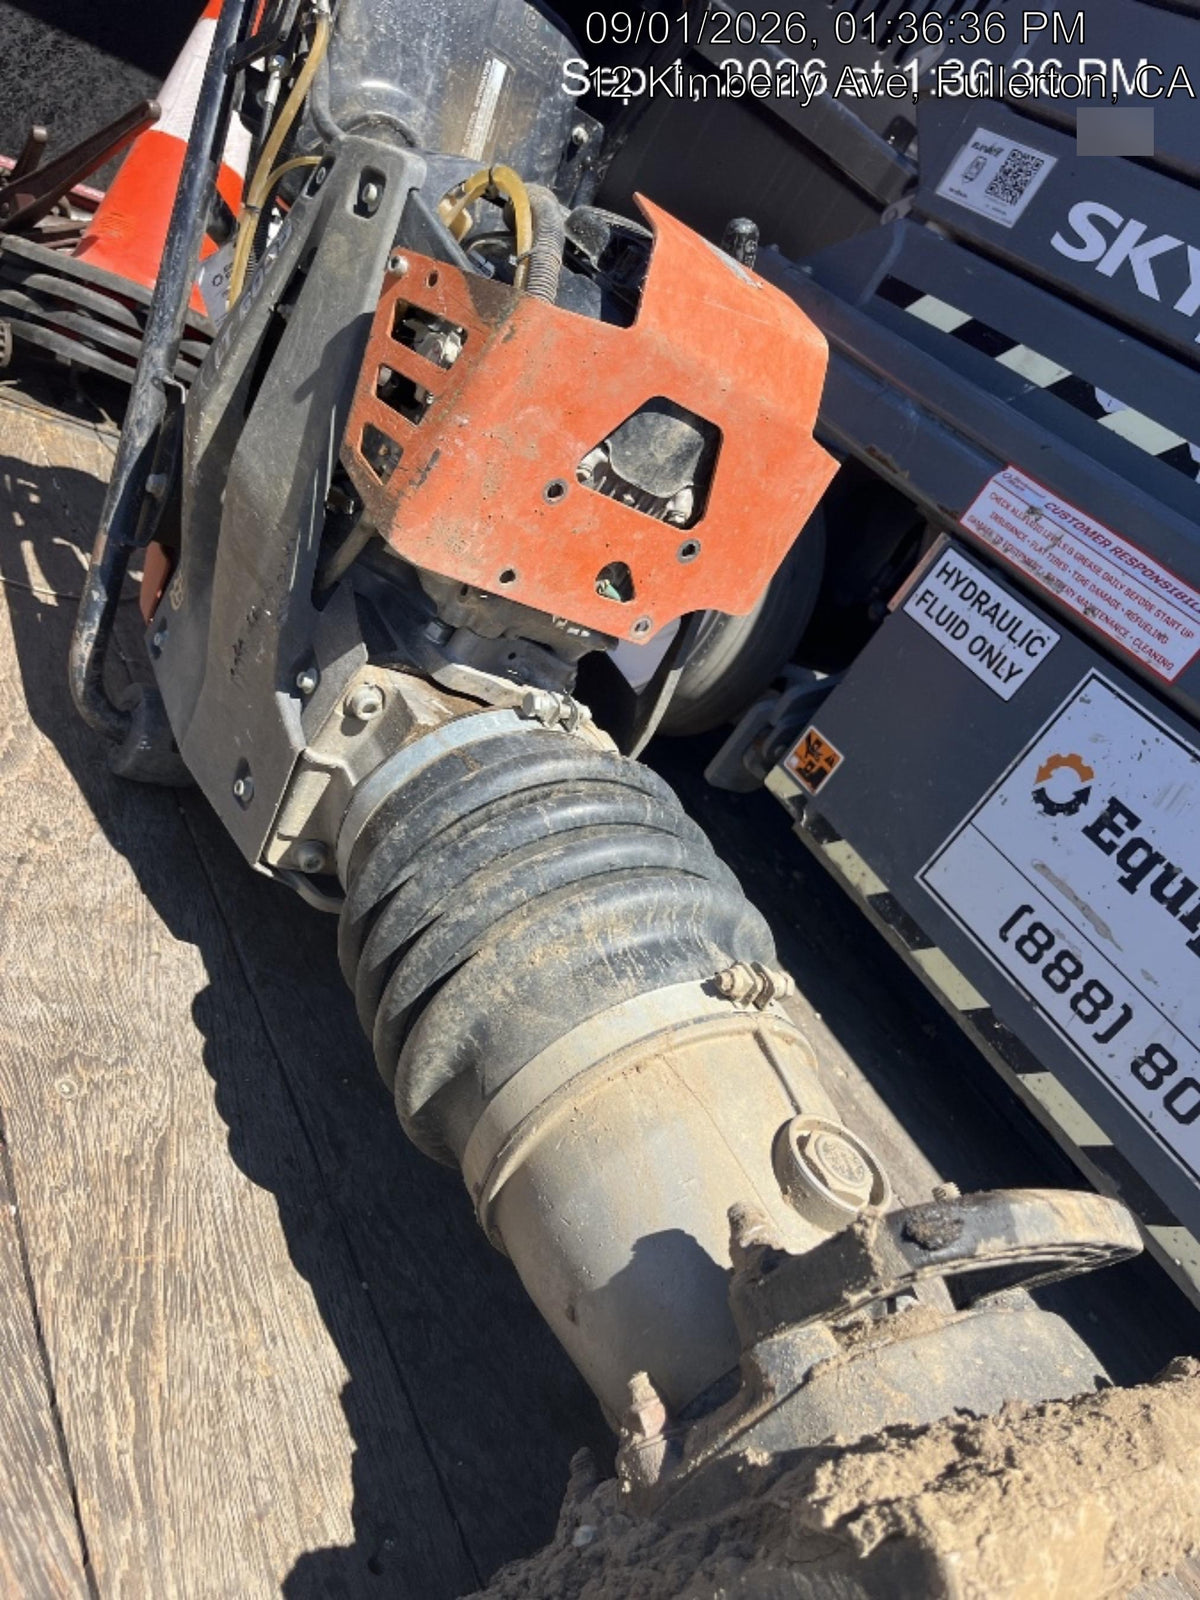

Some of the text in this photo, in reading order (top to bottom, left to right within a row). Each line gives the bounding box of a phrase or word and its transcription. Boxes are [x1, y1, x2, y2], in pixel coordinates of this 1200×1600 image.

[1051, 200, 1200, 340] SKY
[1043, 500, 1112, 549] CUSTOMER
[915, 589, 1023, 685] FLUID ONLY
[935, 561, 1046, 658] HYDRAULIC
[1072, 551, 1103, 576] GREASE
[1100, 571, 1125, 592] DAILY
[1122, 587, 1155, 613] BEFORE
[1152, 608, 1182, 632] START
[1178, 626, 1195, 641] UP
[1123, 608, 1170, 645] REFUELING
[1130, 636, 1175, 672] CLEANING
[1081, 796, 1200, 959] Equi
[999, 904, 1133, 1044] (888)
